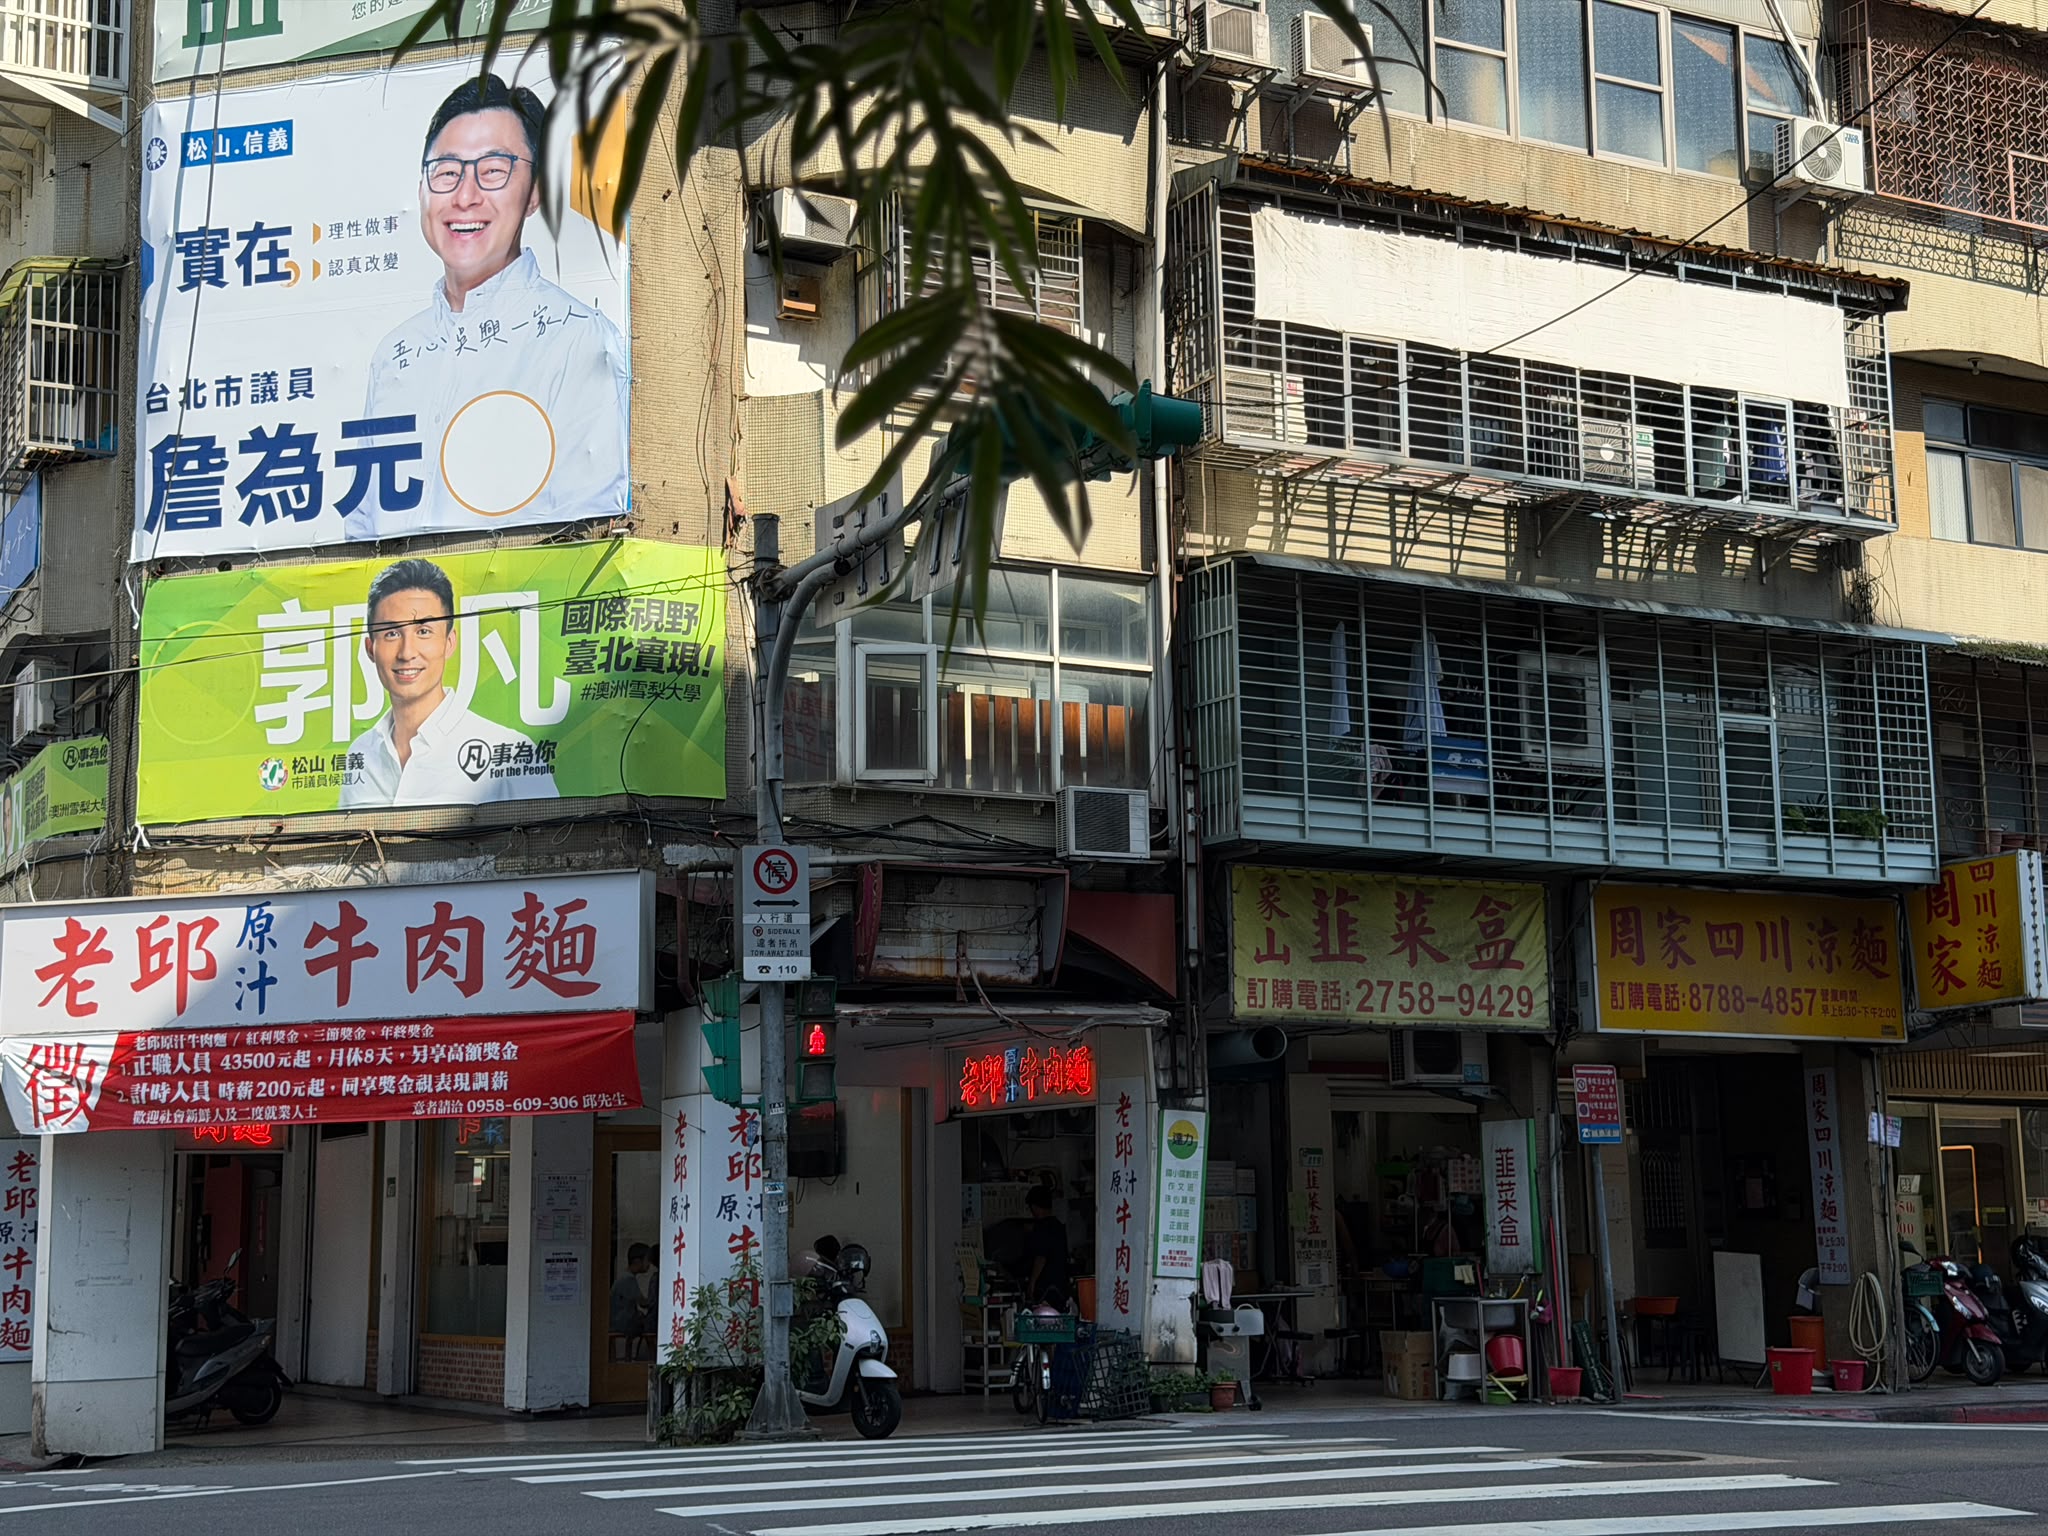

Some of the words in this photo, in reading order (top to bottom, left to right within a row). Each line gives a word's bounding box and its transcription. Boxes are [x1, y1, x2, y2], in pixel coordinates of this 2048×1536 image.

[328, 215, 399, 241] 理性做事
[175, 221, 293, 293] 實在
[328, 251, 399, 278] 認真改變
[145, 367, 315, 416] 台北市議員
[143, 413, 424, 534] 詹為元
[561, 597, 700, 637] 國際視野
[291, 772, 365, 790] 市議員候選人
[490, 767, 505, 779] For
[506, 766, 521, 778] the
[523, 764, 556, 777] People
[757, 912, 793, 924] 人行道
[1926, 869, 1968, 997] 周家
[1969, 861, 2004, 990] 四川涼麵
[786, 949, 804, 958] ZONE
[1609, 905, 1891, 980] 周家四川涼麵
[777, 965, 798, 975] 110
[22, 1041, 100, 1129] 徵
[132, 1103, 318, 1126] 歡迎社會新鮮人及二度就業人士
[411, 1099, 464, 1116] 意者請洽
[466, 1095, 579, 1113] 0958-609-306
[582, 1091, 628, 1109] 邱先生
[1811, 1073, 1839, 1224] 周家四川涼麵
